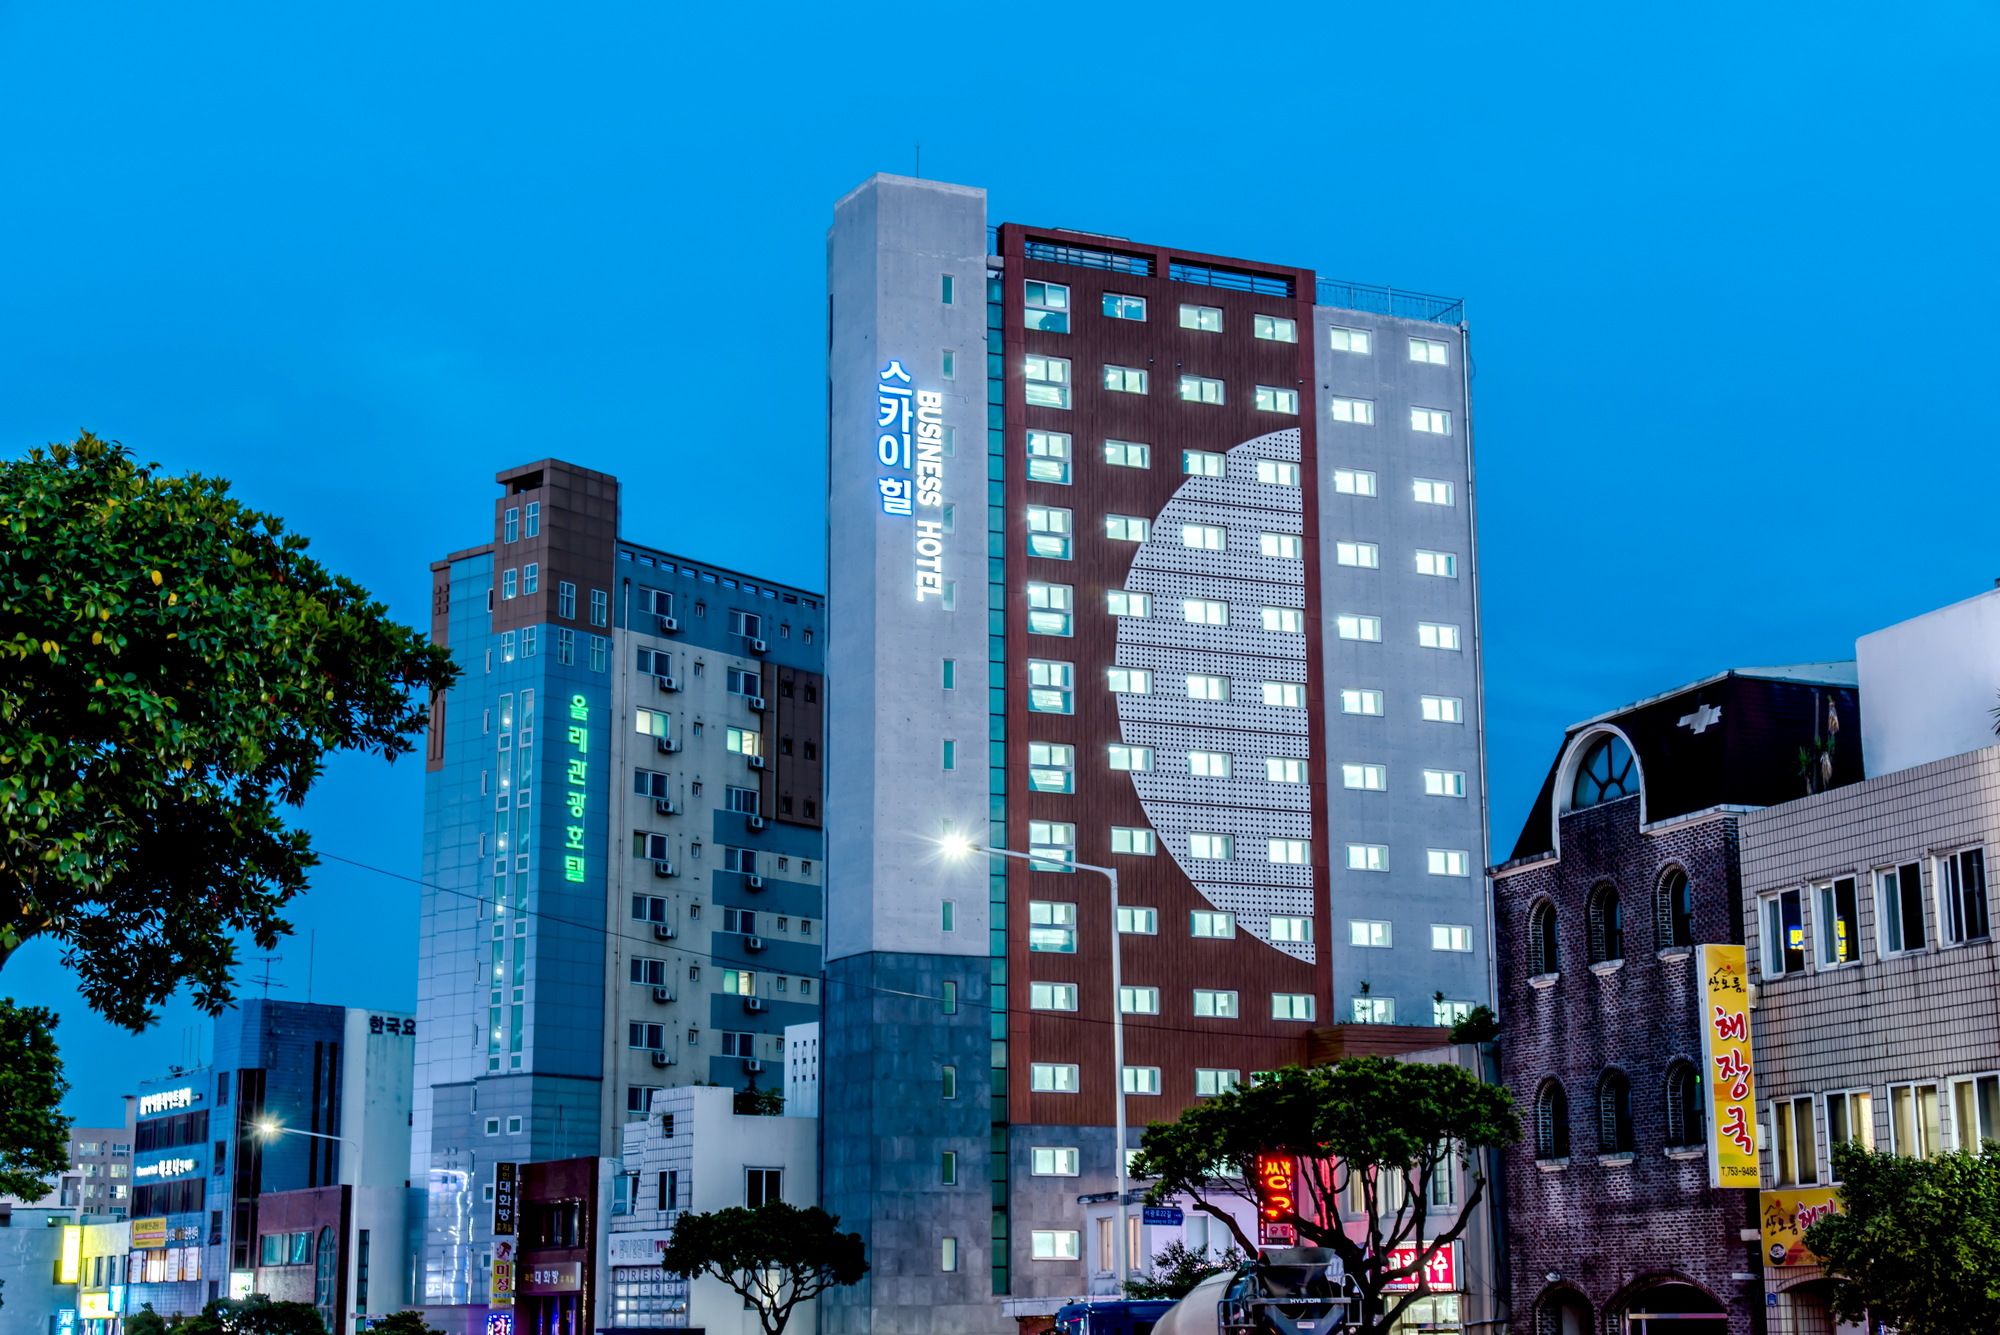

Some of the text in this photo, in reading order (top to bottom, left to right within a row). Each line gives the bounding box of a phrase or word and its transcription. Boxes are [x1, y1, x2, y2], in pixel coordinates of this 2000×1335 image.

[916, 389, 943, 602] BUSINESS HOTEL
[1713, 1006, 1754, 1155] 해장국
